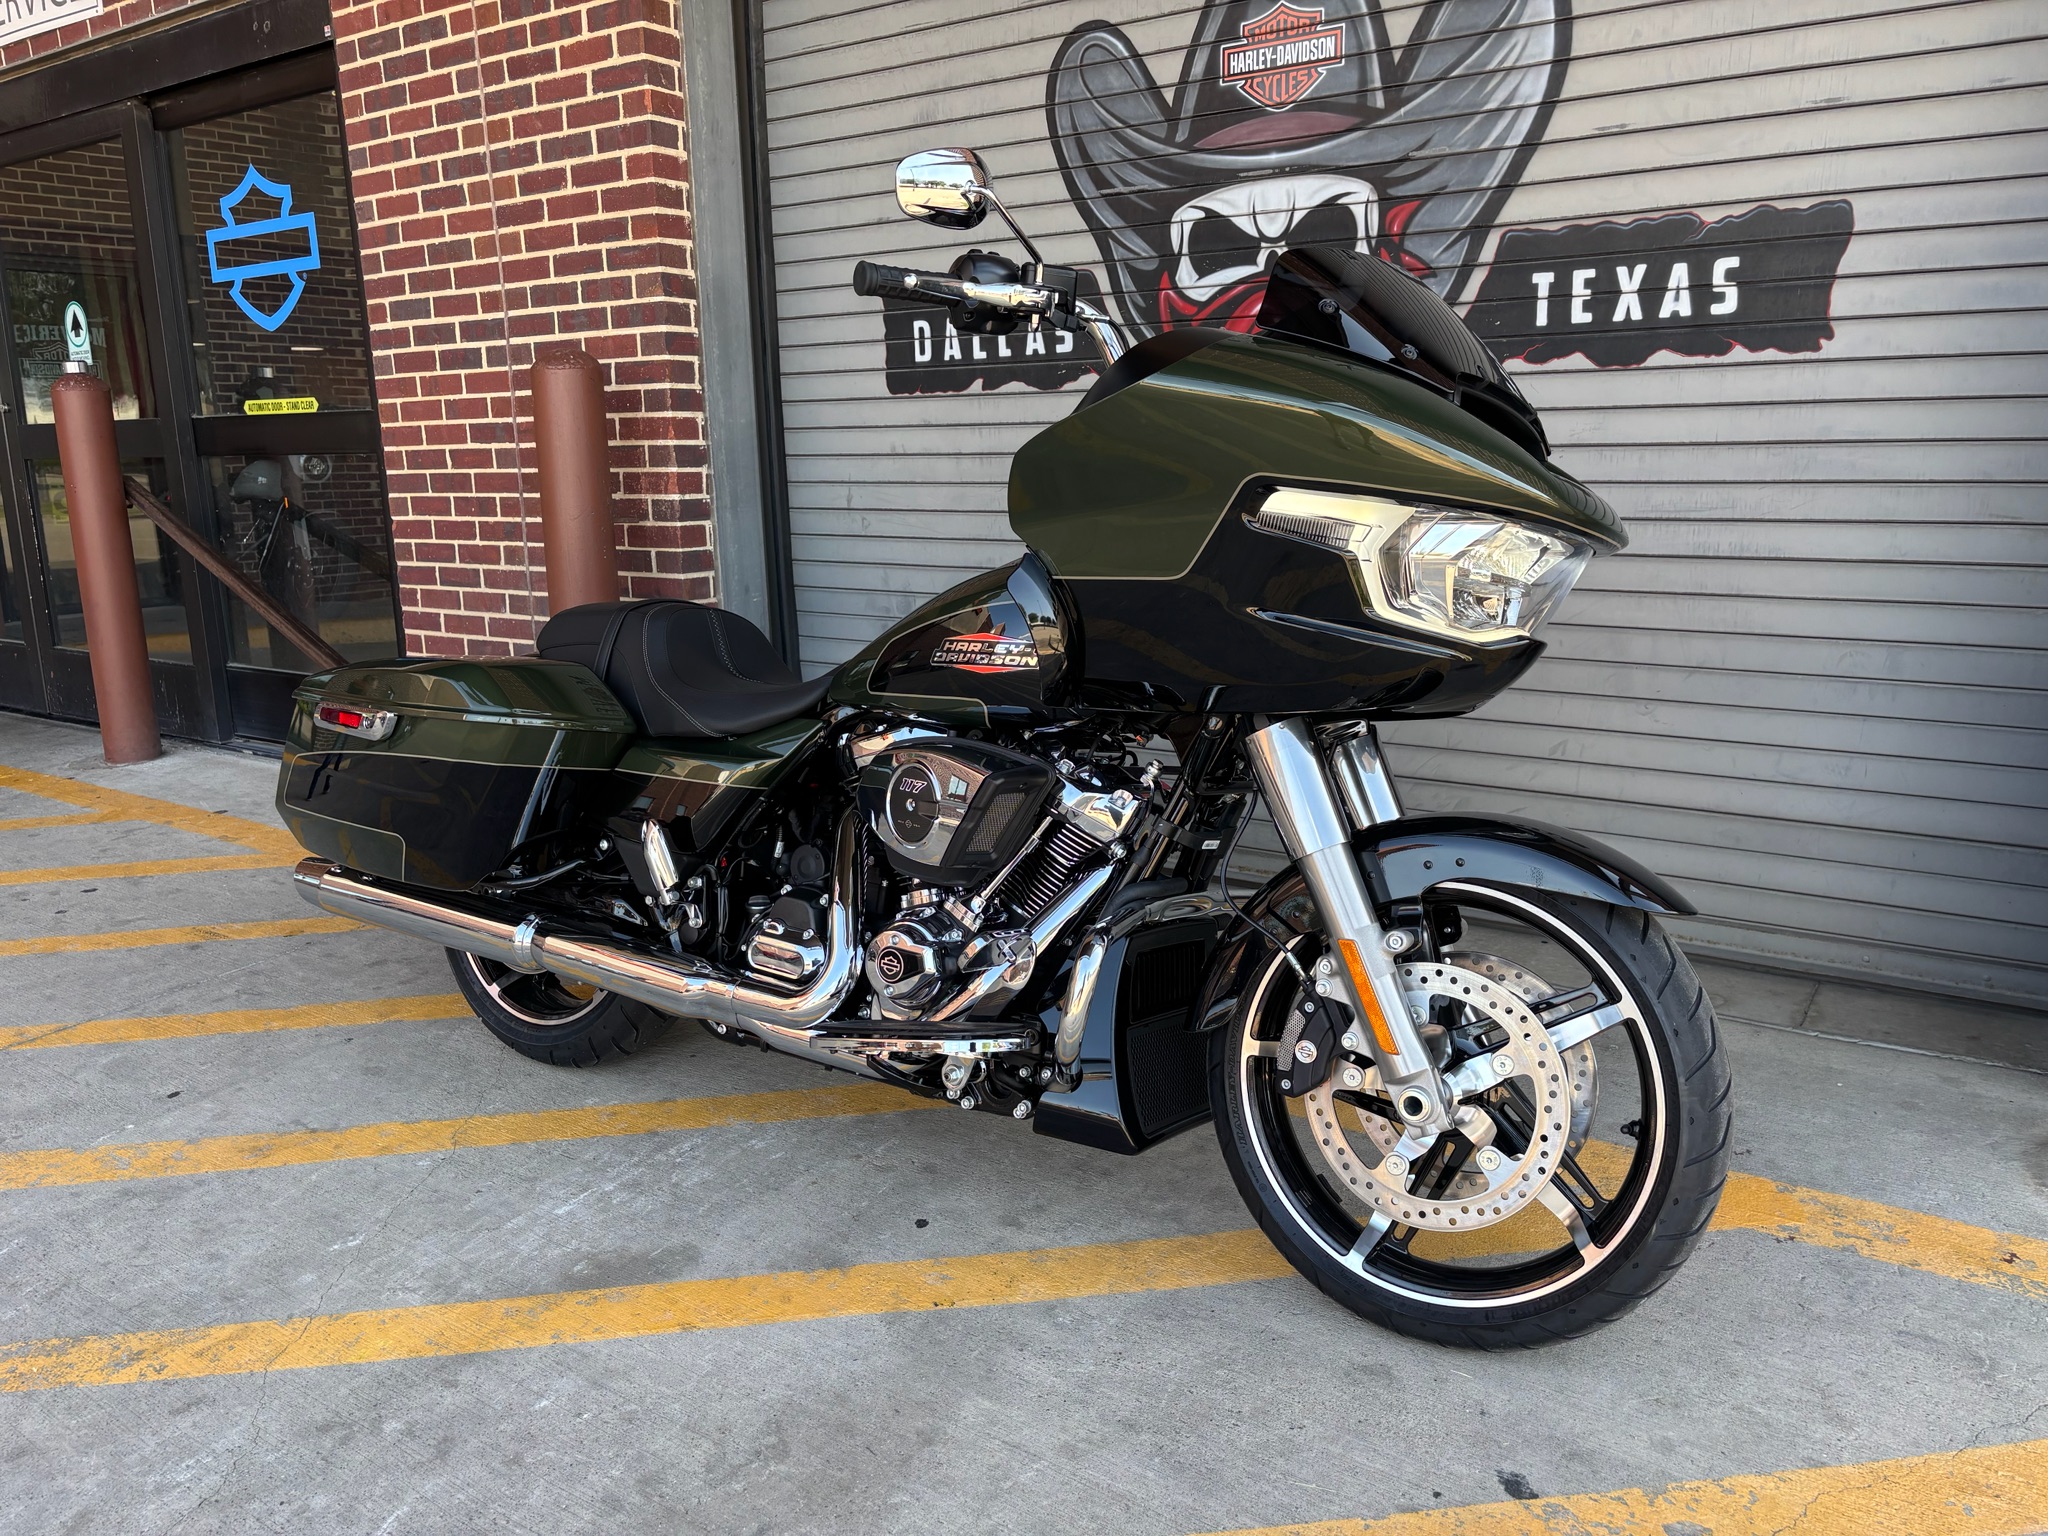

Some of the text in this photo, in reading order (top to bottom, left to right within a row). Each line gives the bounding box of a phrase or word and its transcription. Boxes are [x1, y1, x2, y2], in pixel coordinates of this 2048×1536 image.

[1254, 13, 1311, 42] MOTOR
[1230, 36, 1335, 74] HARLEY-DAVIDSON
[1253, 70, 1308, 101] CYCLES
[1532, 256, 1740, 326] TEXAS
[913, 318, 1073, 362] DALLAS
[248, 402, 270, 412] AUTOMATIC
[271, 402, 283, 412] DOOR
[286, 401, 300, 411] STAND
[301, 400, 314, 410] CLEAR
[934, 652, 1038, 666] DAVIDSON
[900, 778, 927, 793] 117
